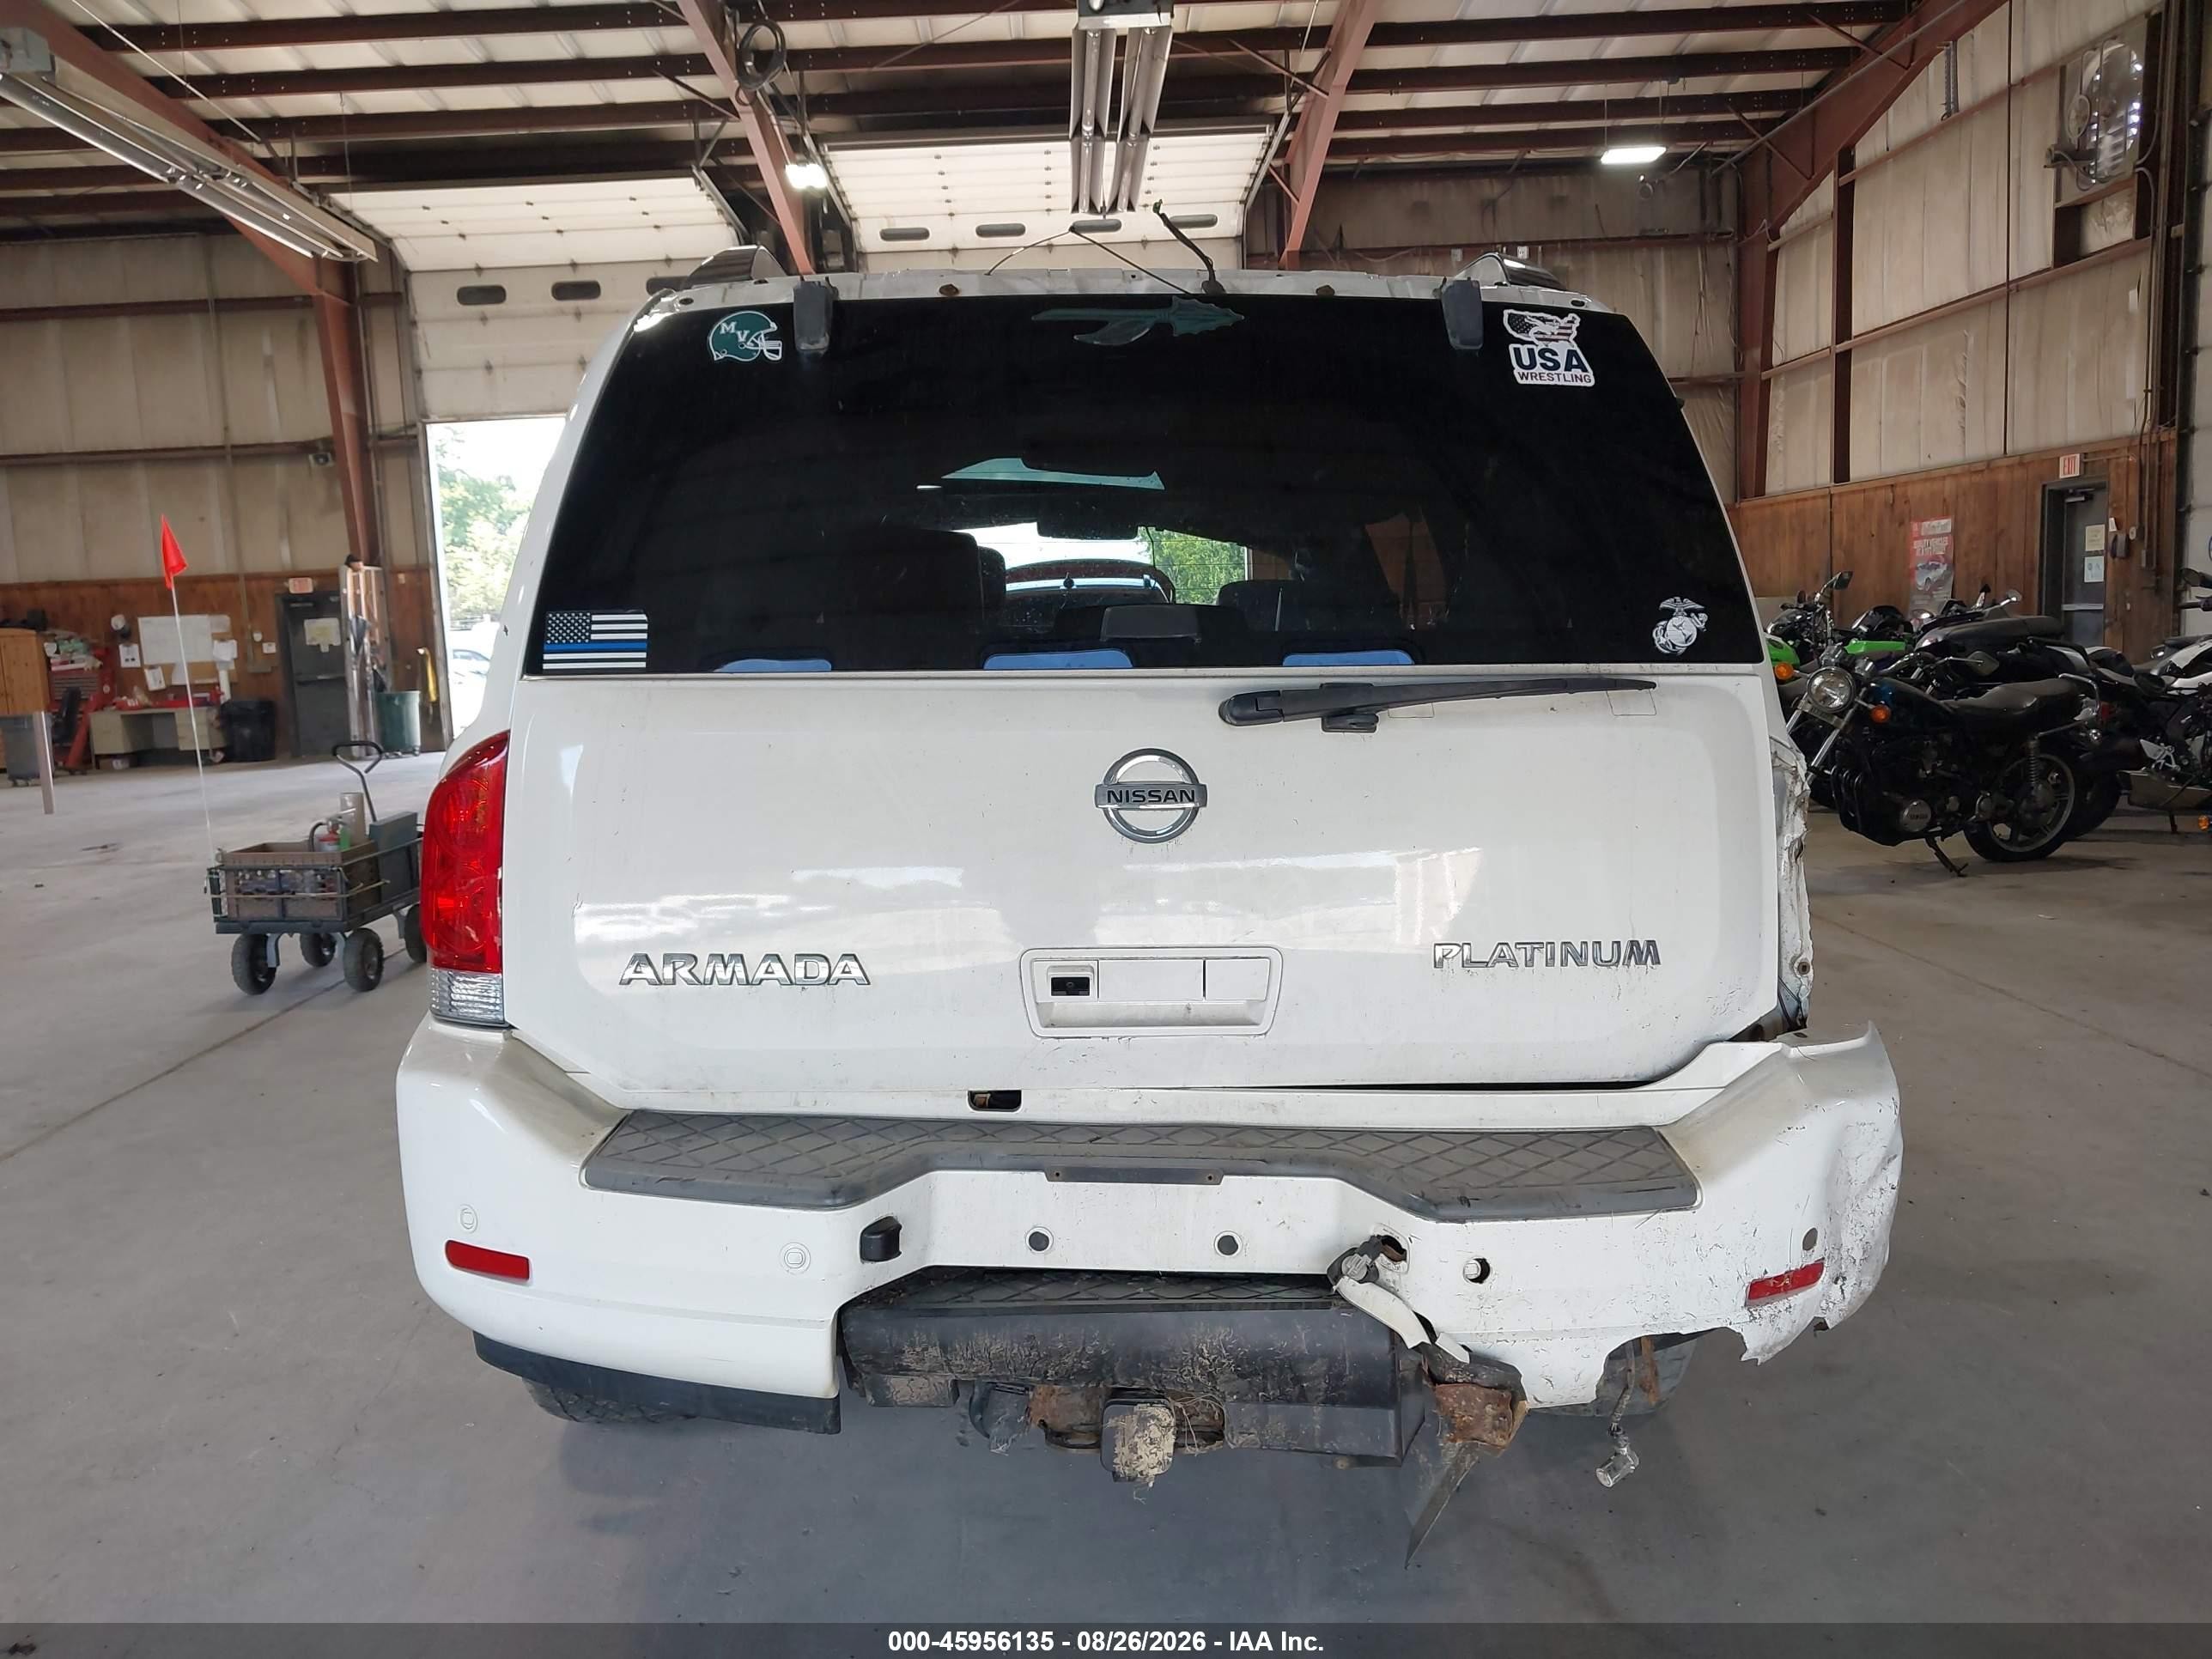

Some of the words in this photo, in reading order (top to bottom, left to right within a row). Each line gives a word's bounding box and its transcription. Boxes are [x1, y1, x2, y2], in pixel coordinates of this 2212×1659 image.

[720, 321, 750, 342] MV
[1513, 347, 1589, 372] USA
[1518, 372, 1592, 383] WRESTLING
[1107, 789, 1194, 804] NISSAN
[1433, 939, 1662, 969] PLATINUM
[619, 952, 871, 986] ARMADA
